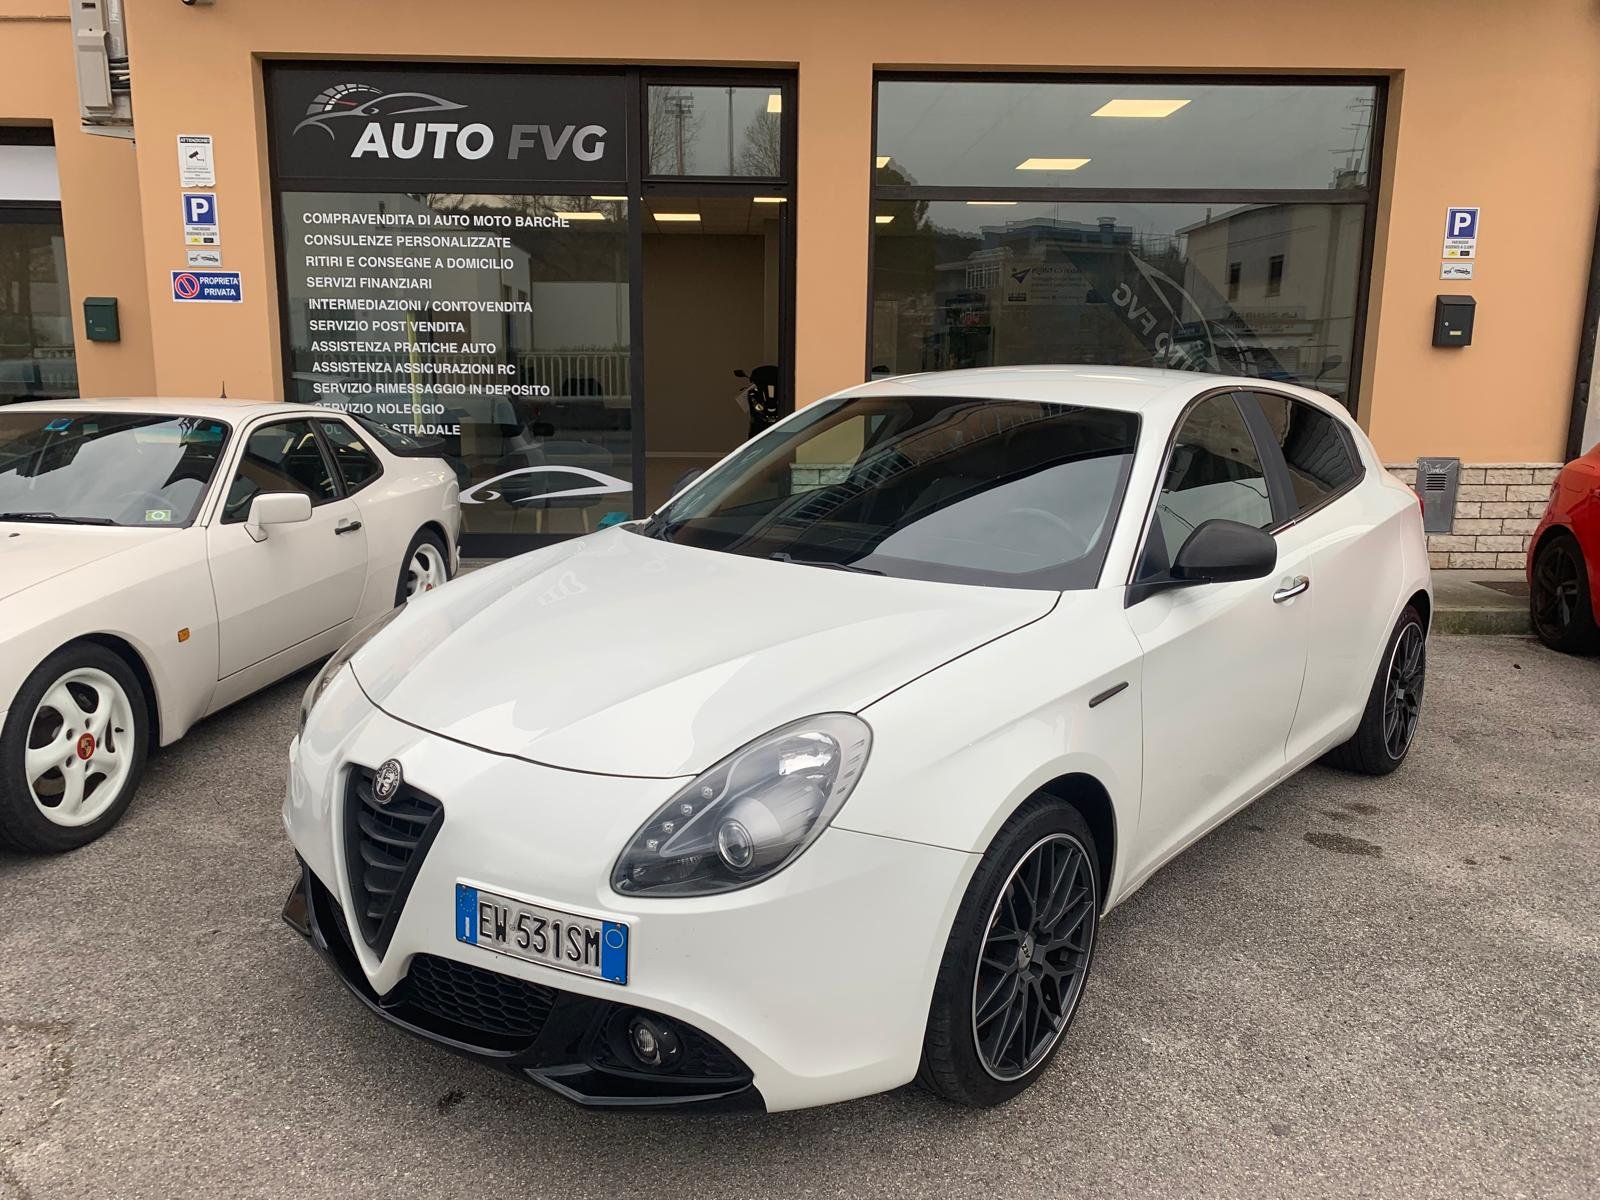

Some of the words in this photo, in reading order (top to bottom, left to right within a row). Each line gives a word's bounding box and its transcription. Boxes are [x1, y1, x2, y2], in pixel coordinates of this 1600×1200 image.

[351, 122, 494, 160] AUTO
[507, 124, 608, 162] FVG
[190, 197, 209, 222] P
[303, 213, 415, 226] COMPRAVENDITA
[418, 215, 431, 226] DI
[434, 215, 470, 226] AUTO
[474, 216, 512, 227] MOTO
[516, 217, 570, 228] BARCHE
[1453, 212, 1472, 236] P
[304, 235, 393, 247] CONSULENZE
[397, 236, 511, 248] PERSONALIZZATE
[306, 256, 342, 267] RITIRI
[347, 257, 355, 267] E
[358, 257, 431, 268] CONSEGNE
[435, 258, 444, 268] A
[447, 258, 514, 270] DOMICILIO
[307, 277, 356, 288] SERVIZI
[360, 278, 432, 289] FINANZIARI
[204, 287, 236, 296] PRIVATA
[309, 299, 422, 311] INTERMEDIAZIONI
[425, 301, 430, 311] /
[432, 301, 532, 313] CONTOVENDITA
[310, 320, 369, 331] SERVIZIO
[373, 321, 407, 332] POST
[411, 322, 465, 333] VENDITA
[311, 341, 391, 353] ASSISTENZA
[395, 342, 458, 353] PRATICHE
[461, 343, 497, 354] AUTO
[312, 361, 391, 373] ASSISTENZA
[395, 363, 494, 374] ASSICURAZIONI
[498, 364, 516, 375] RC
[314, 383, 372, 393] SERVIZIO
[376, 383, 466, 395] RIMESSAGGIO
[470, 385, 482, 395] IN
[486, 385, 550, 396] DEPOSITO
[377, 404, 445, 415] NOLEGGIO
[479, 901, 508, 942] EW
[517, 912, 600, 966] 531SM
